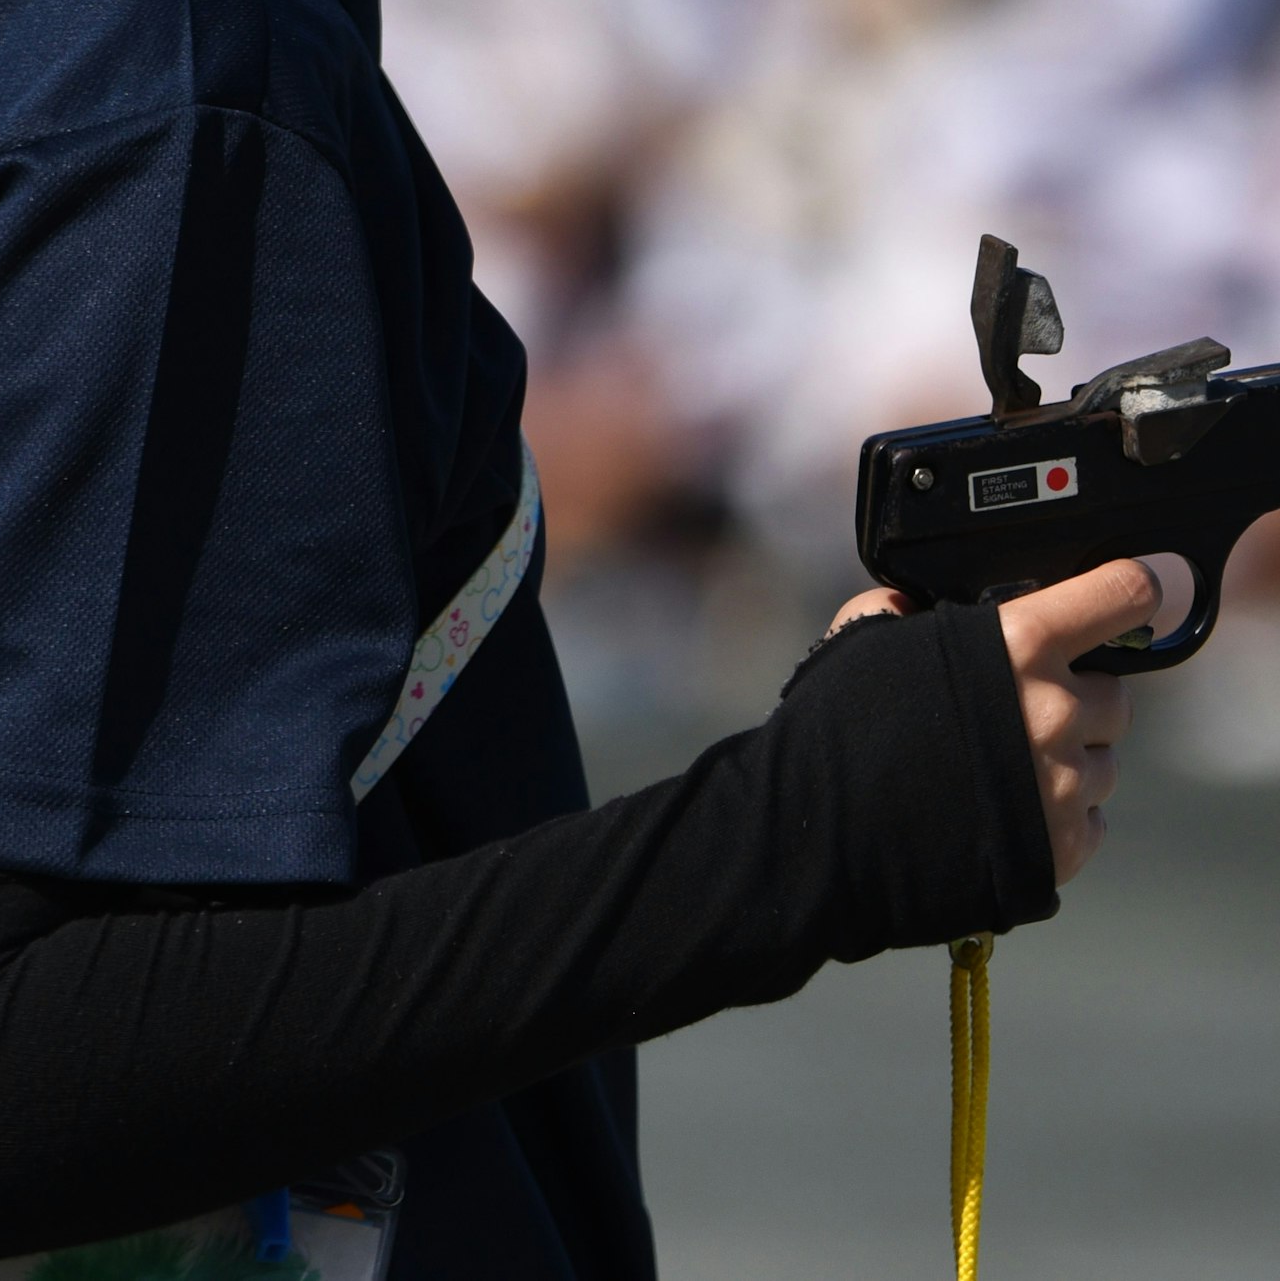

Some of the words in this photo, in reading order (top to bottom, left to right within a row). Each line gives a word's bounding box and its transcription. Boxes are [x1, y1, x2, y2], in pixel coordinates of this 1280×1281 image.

[981, 475, 1008, 486] FIRST
[982, 481, 1028, 495] STARTING
[983, 492, 1016, 503] SIGNAL
